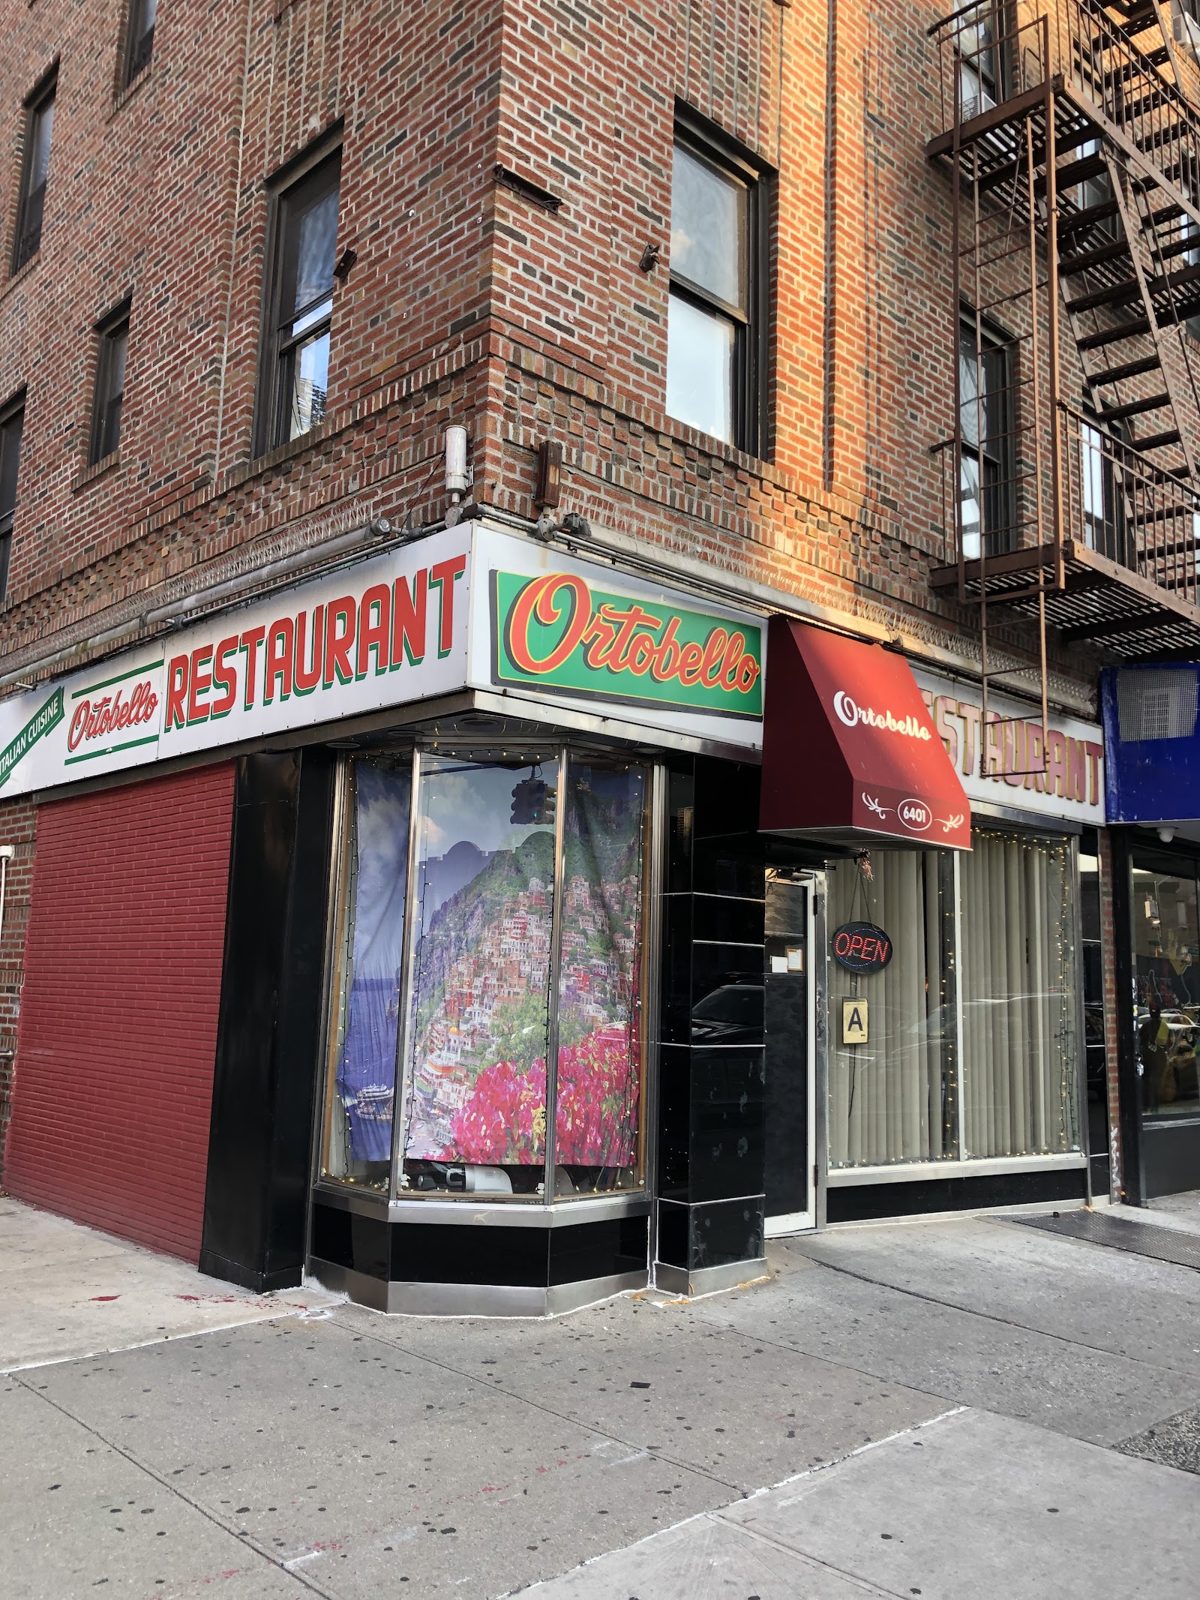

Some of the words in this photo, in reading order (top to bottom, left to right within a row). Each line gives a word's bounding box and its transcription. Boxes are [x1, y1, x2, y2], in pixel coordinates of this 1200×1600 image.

[165, 554, 466, 733] RESTAURANT
[504, 573, 760, 694] Ortobello
[27, 697, 59, 743] CUISINE
[68, 681, 158, 752] Ortobello
[834, 690, 932, 740] Ortobello
[903, 806, 926, 823] 6401
[835, 932, 889, 963] OPEN
[848, 1007, 864, 1032] A
